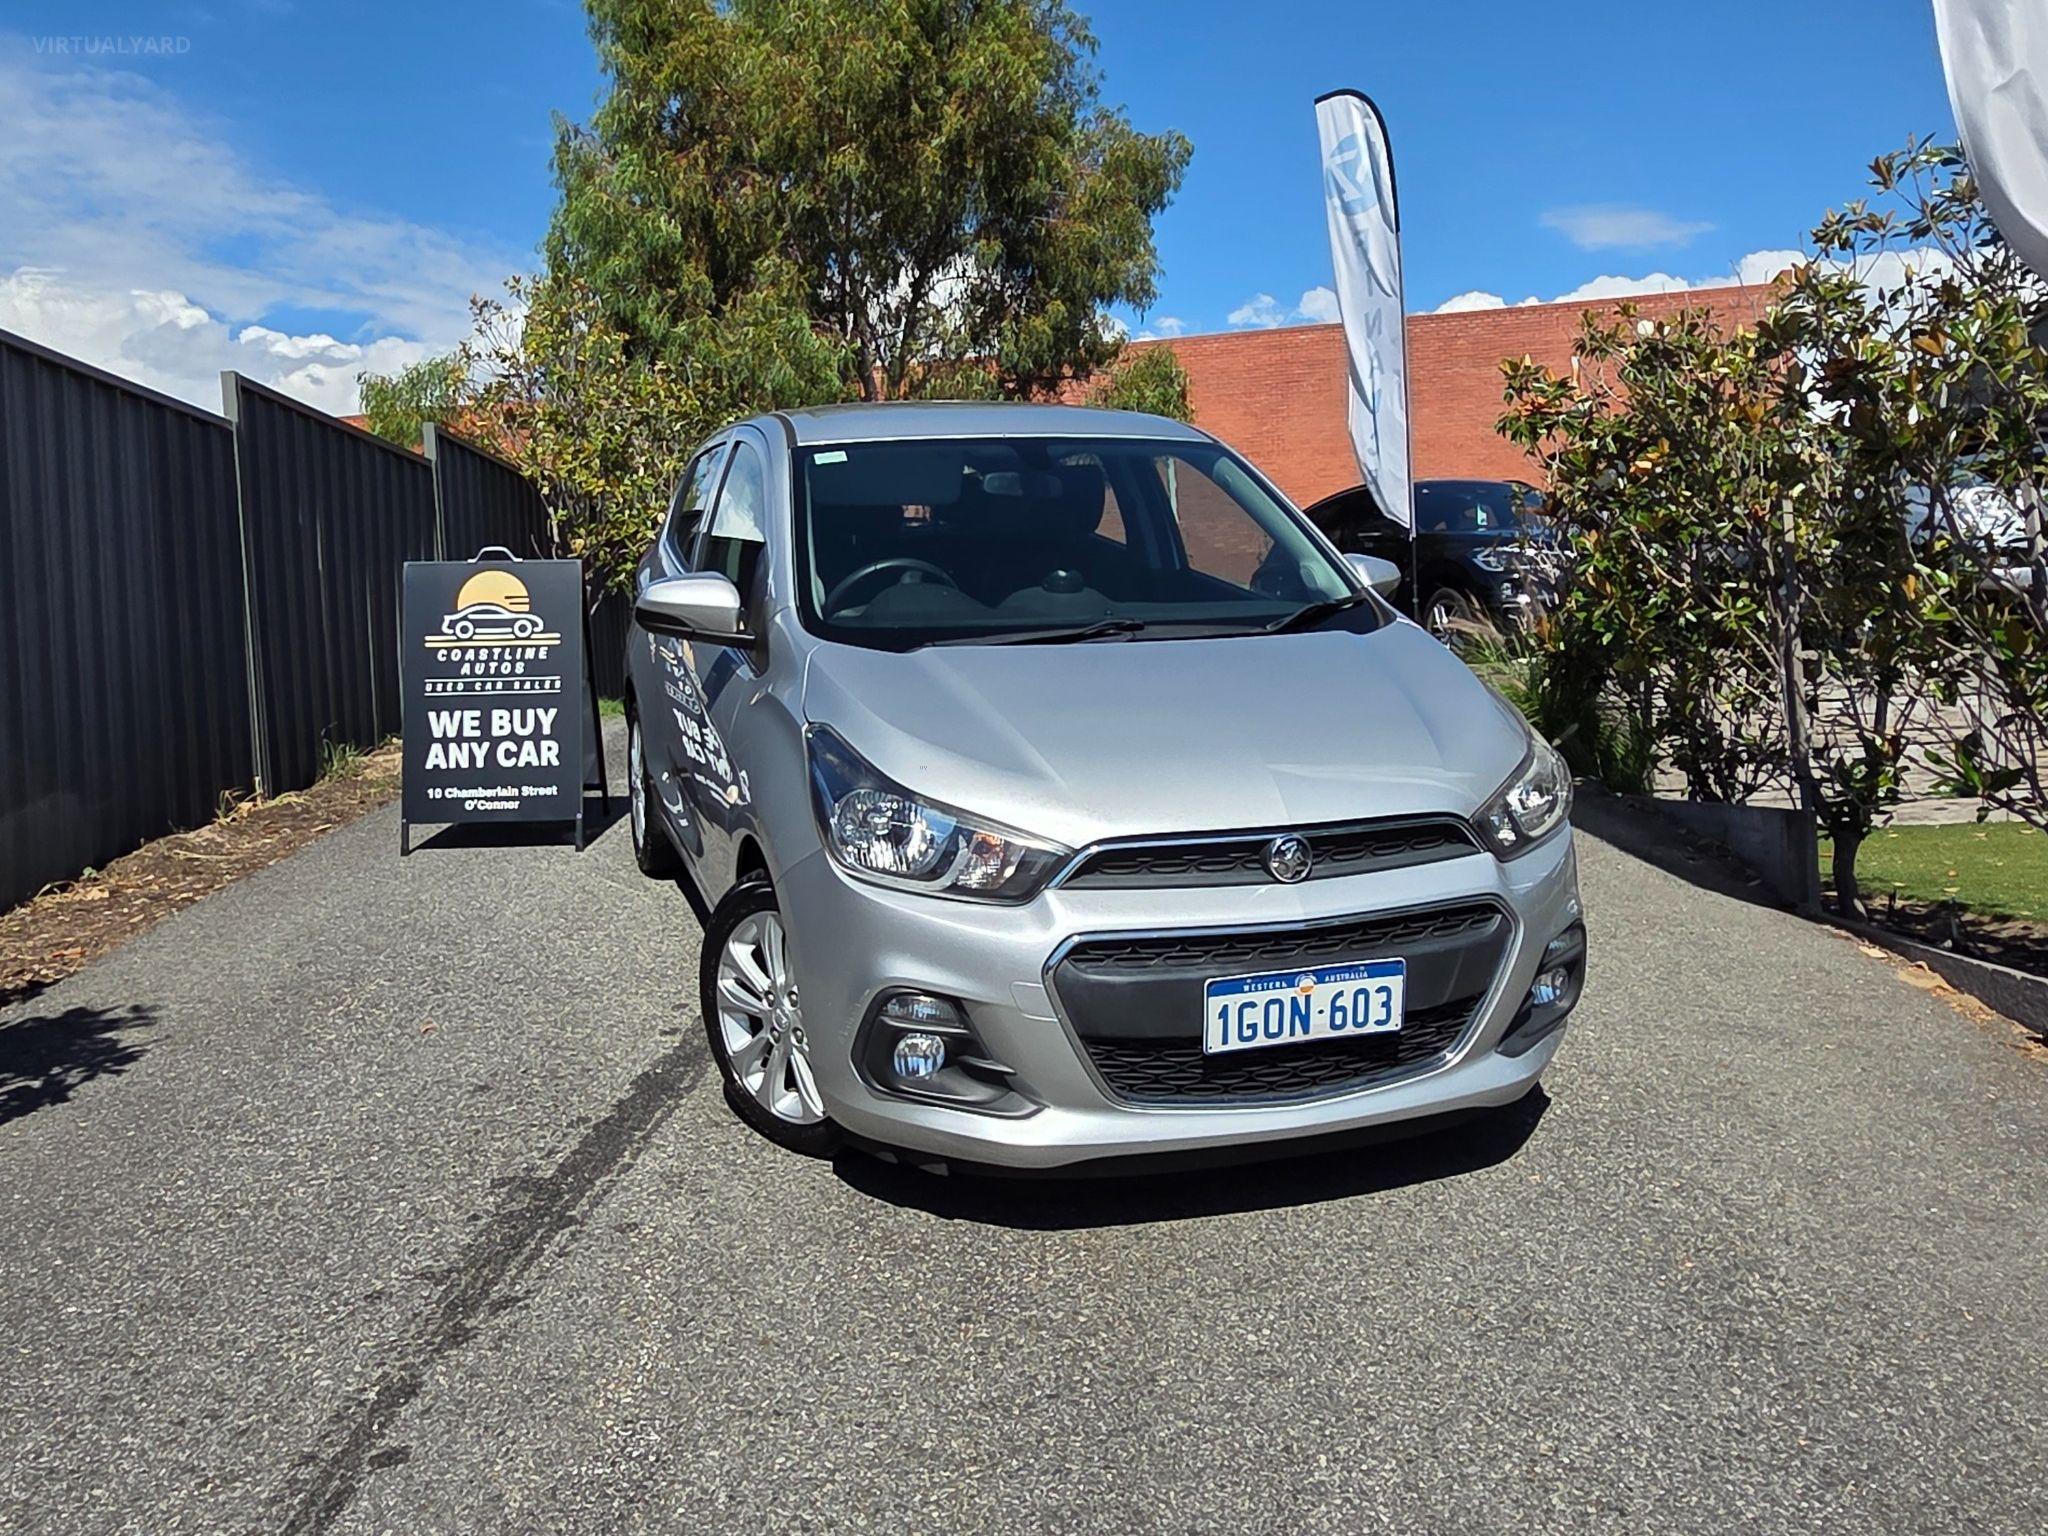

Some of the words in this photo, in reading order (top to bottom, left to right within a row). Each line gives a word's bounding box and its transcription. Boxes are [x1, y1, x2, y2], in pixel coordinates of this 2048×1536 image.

[437, 647, 548, 661] COASTLINE
[460, 662, 525, 675] AUTOS
[428, 710, 481, 738] WE
[491, 708, 558, 737] BUY
[425, 742, 490, 769] ANY
[496, 740, 560, 767] CAR
[427, 788, 442, 799] 10
[444, 786, 519, 798] Chamberlain
[521, 785, 558, 797] Street
[464, 799, 520, 811] O'Connor
[1243, 981, 1288, 993] WESTERN
[1325, 971, 1369, 983] AUSTRALIA
